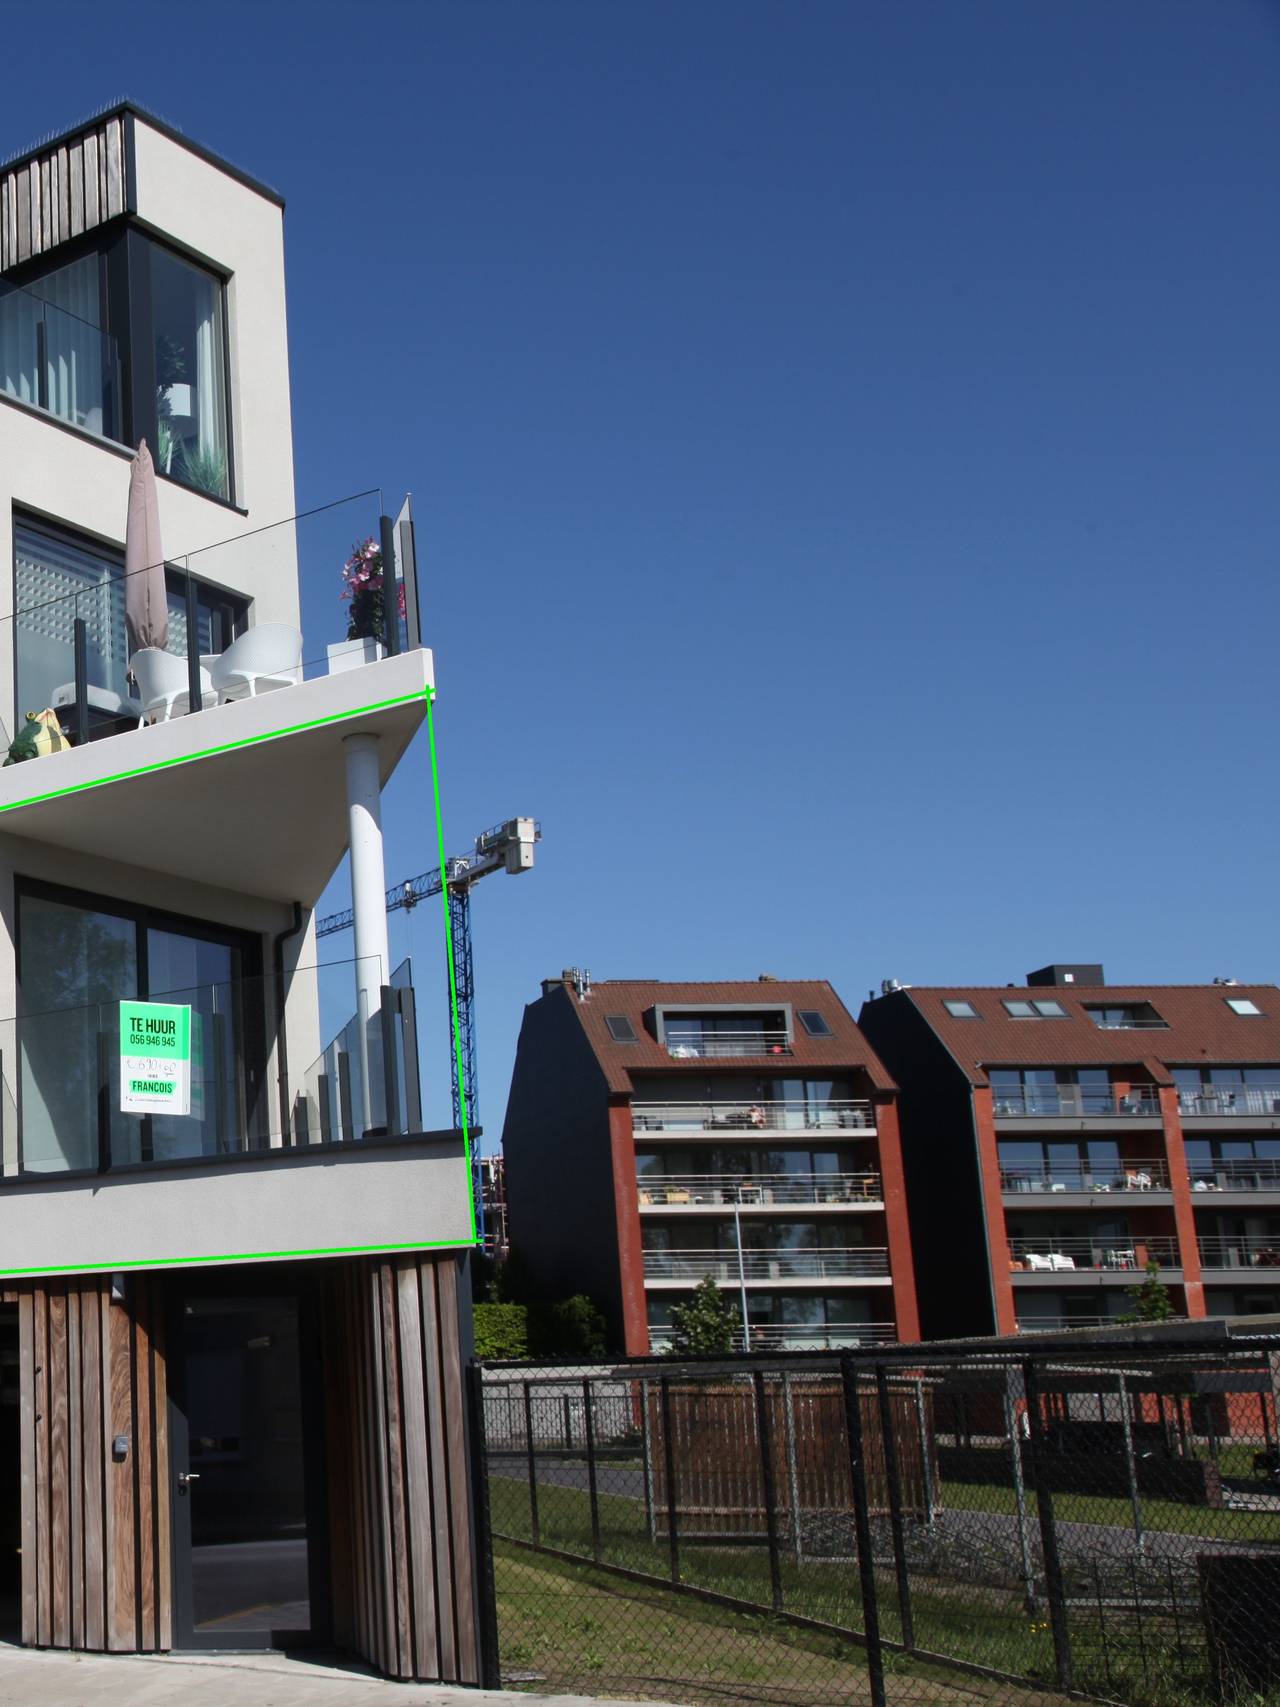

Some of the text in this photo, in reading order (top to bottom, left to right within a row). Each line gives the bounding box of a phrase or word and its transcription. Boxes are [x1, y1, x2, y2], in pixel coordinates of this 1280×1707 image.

[130, 1017, 176, 1035] TE HUUR
[130, 1034, 176, 1047] 056 946 945
[132, 1080, 173, 1094] FRANCOIS
